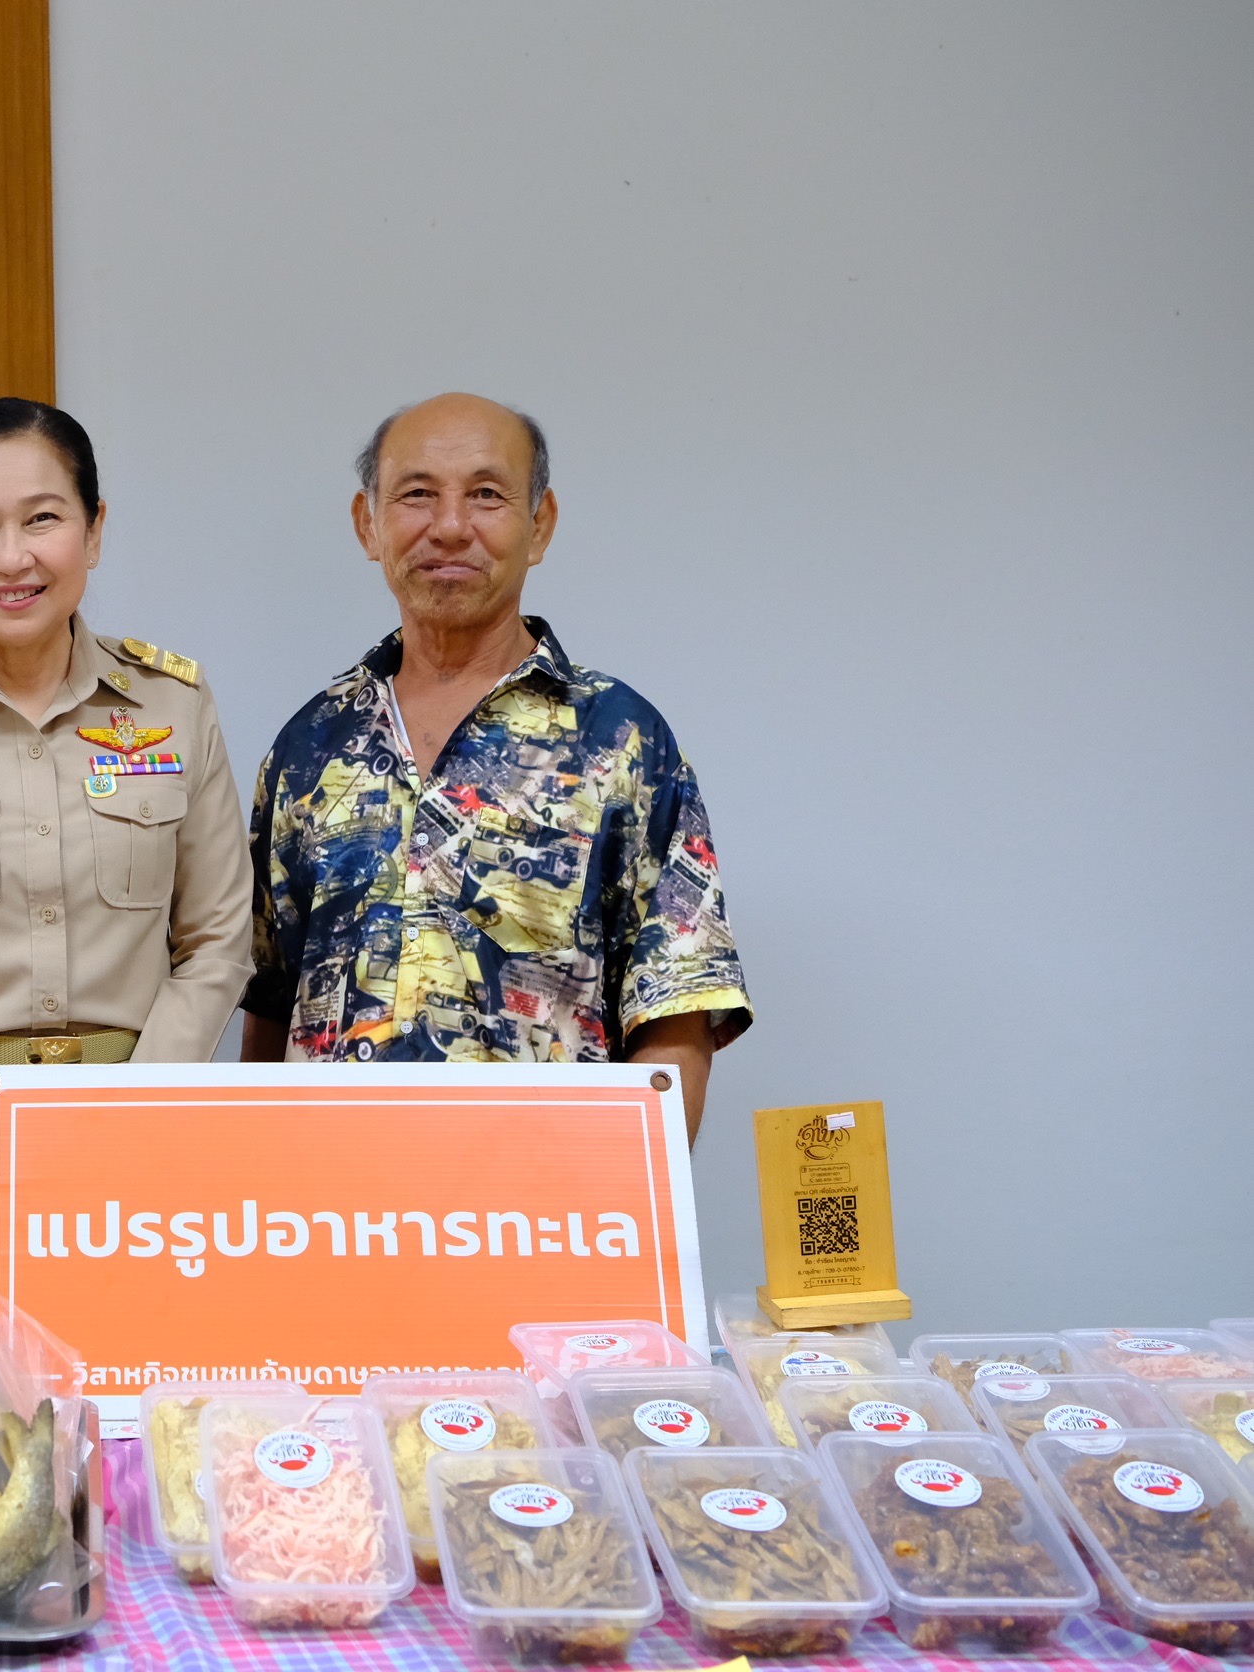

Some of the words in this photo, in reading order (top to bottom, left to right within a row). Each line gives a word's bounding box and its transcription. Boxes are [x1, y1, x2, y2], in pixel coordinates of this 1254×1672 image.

[26, 1199, 641, 1278] แปรรูปอาหารทะเล
